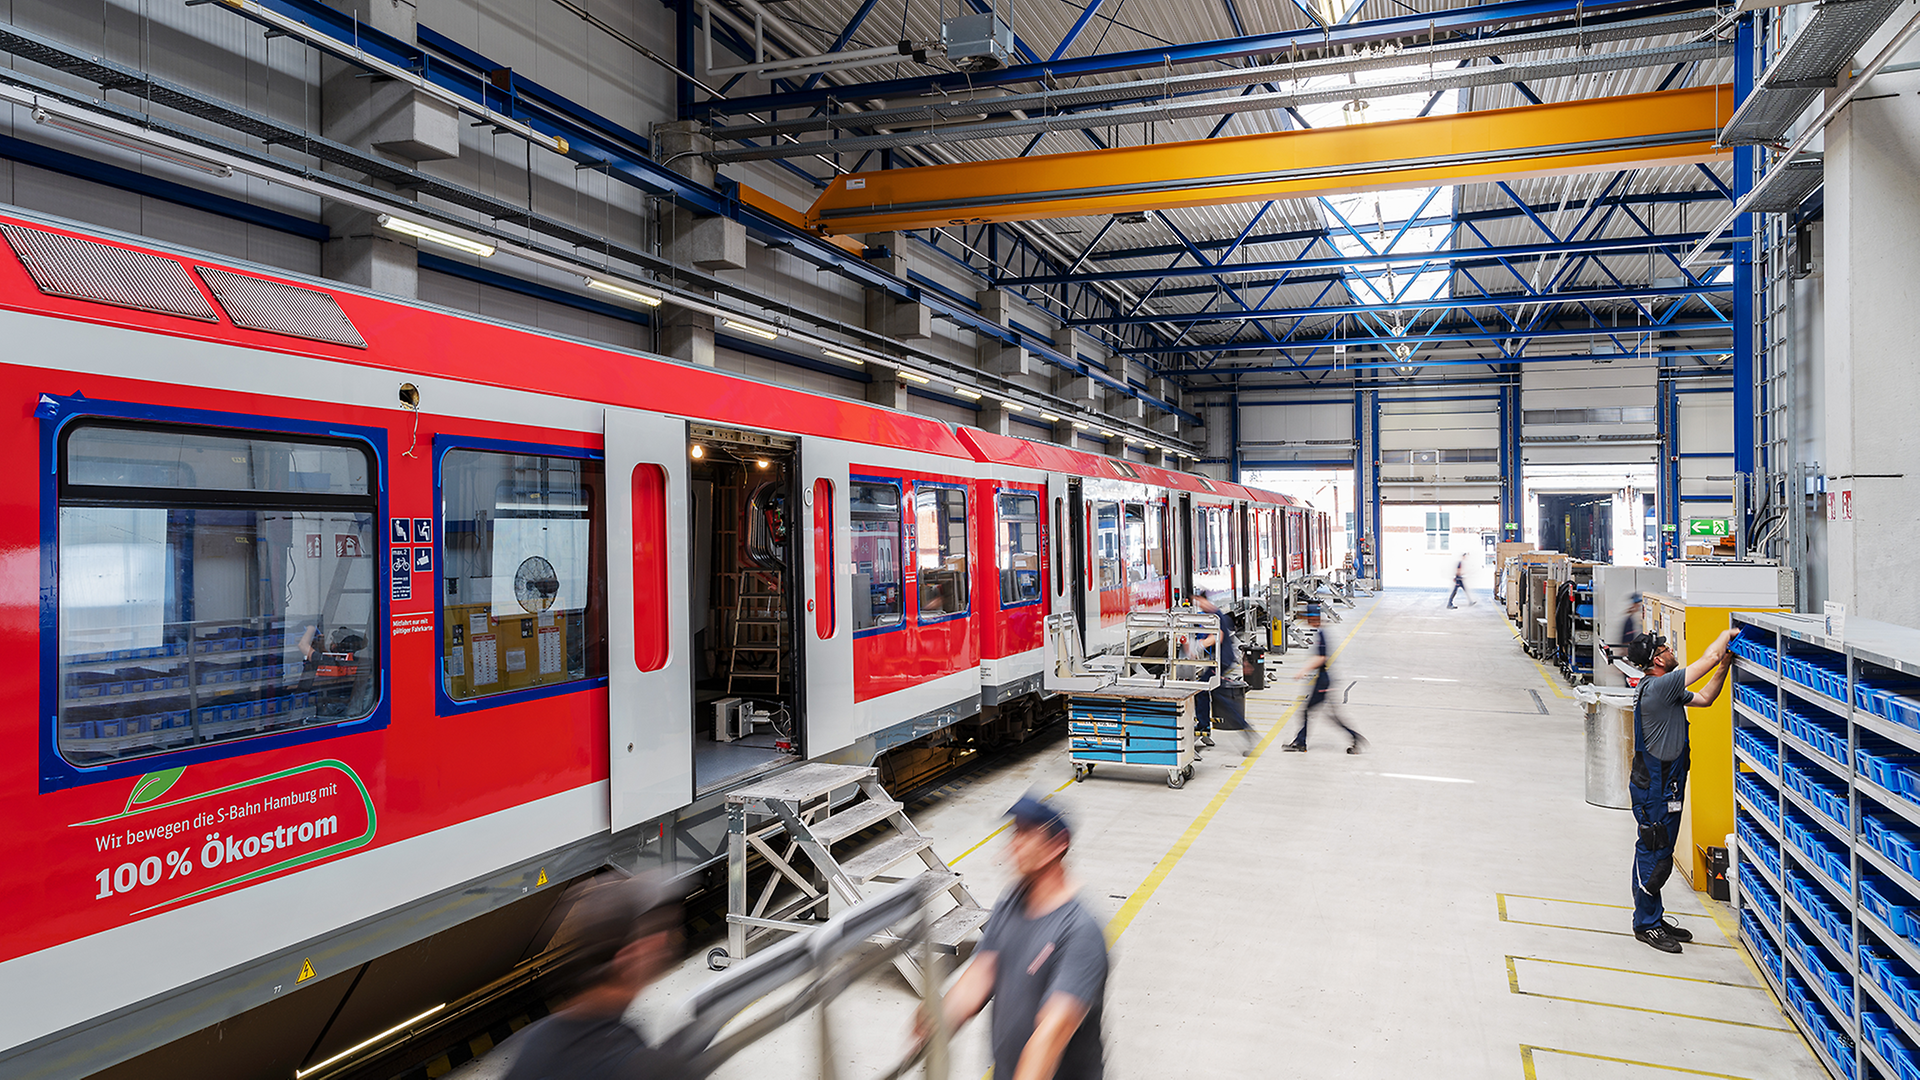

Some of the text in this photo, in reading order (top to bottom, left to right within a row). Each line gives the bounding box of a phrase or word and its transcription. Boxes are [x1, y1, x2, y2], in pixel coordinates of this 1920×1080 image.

[392, 619, 412, 627] Mitfahrt
[420, 617, 428, 625] mit
[411, 625, 433, 633] Fahrkarte
[95, 783, 338, 852] Wir bewegen die S-Bahn Hamburg mit
[200, 814, 338, 869] Ökostrom
[273, 984, 282, 994] 77
